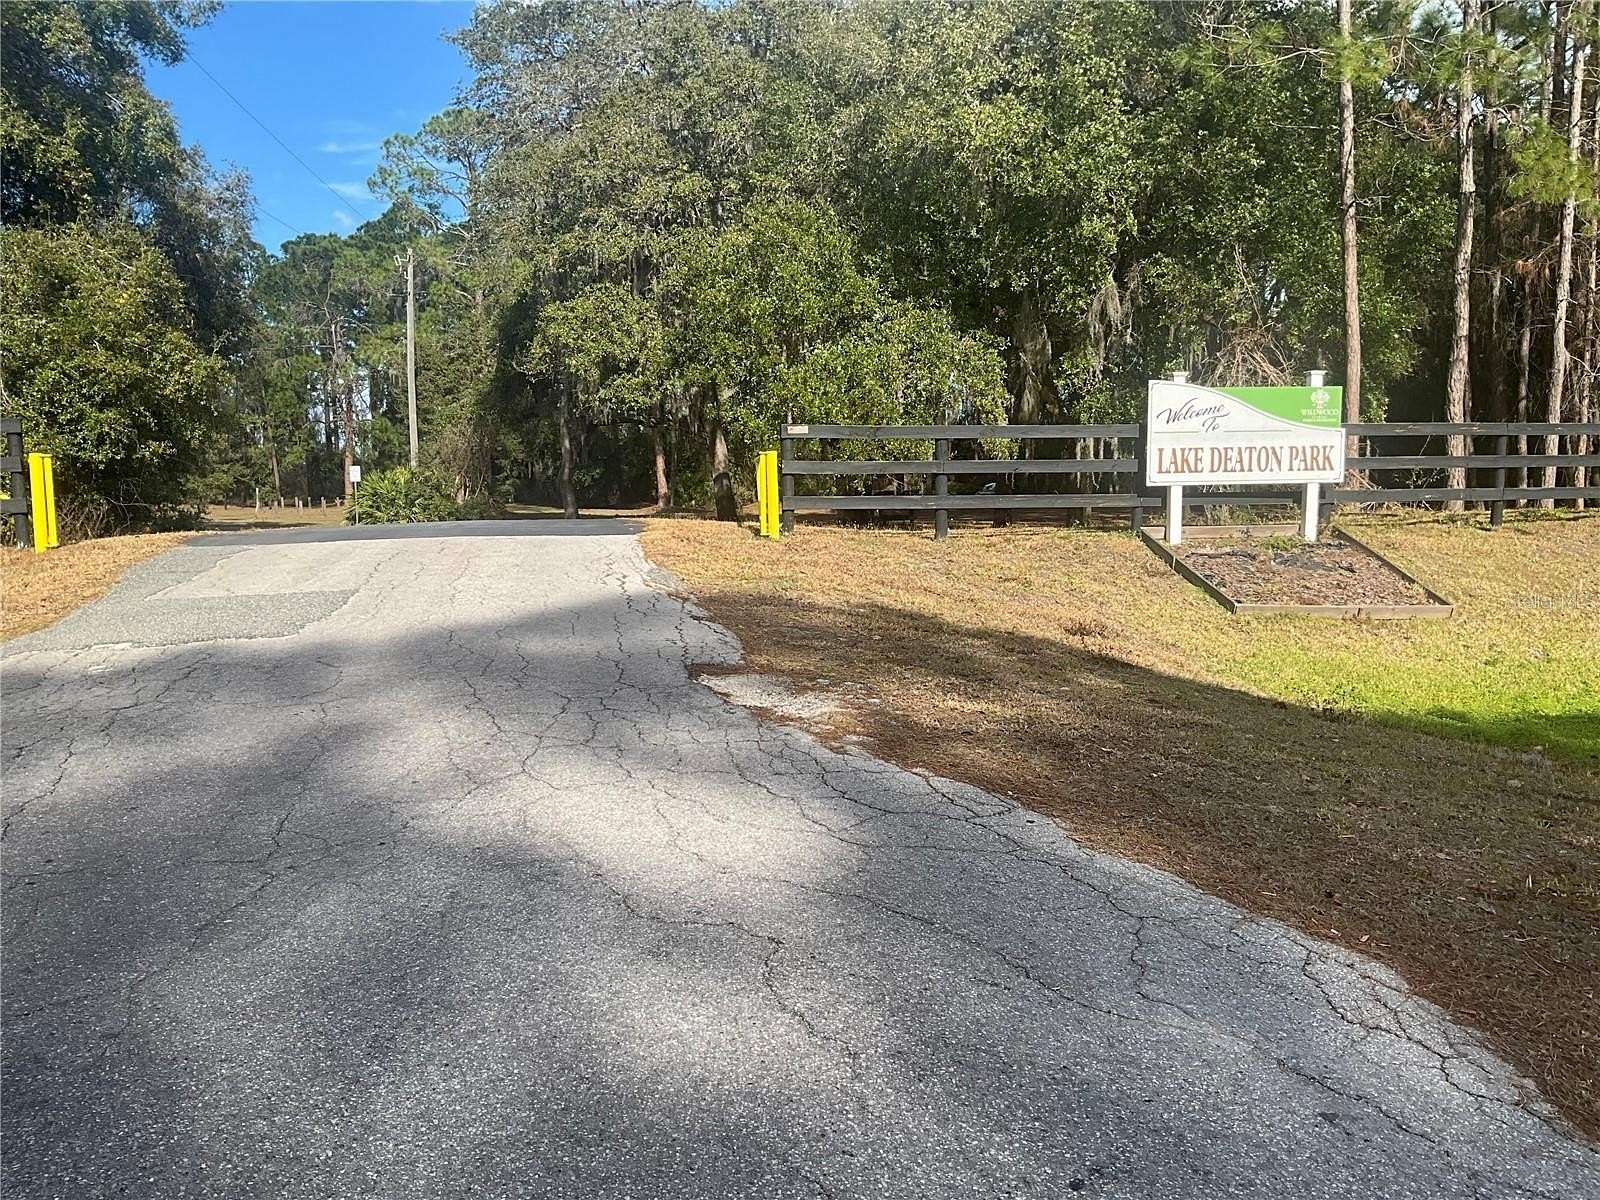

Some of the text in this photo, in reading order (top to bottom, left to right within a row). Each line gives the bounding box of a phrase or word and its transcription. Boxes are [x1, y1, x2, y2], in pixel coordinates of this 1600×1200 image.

[1156, 397, 1231, 424] Welcome
[1202, 416, 1220, 433] To
[1156, 445, 1335, 474] LAKE DEATON PARK
